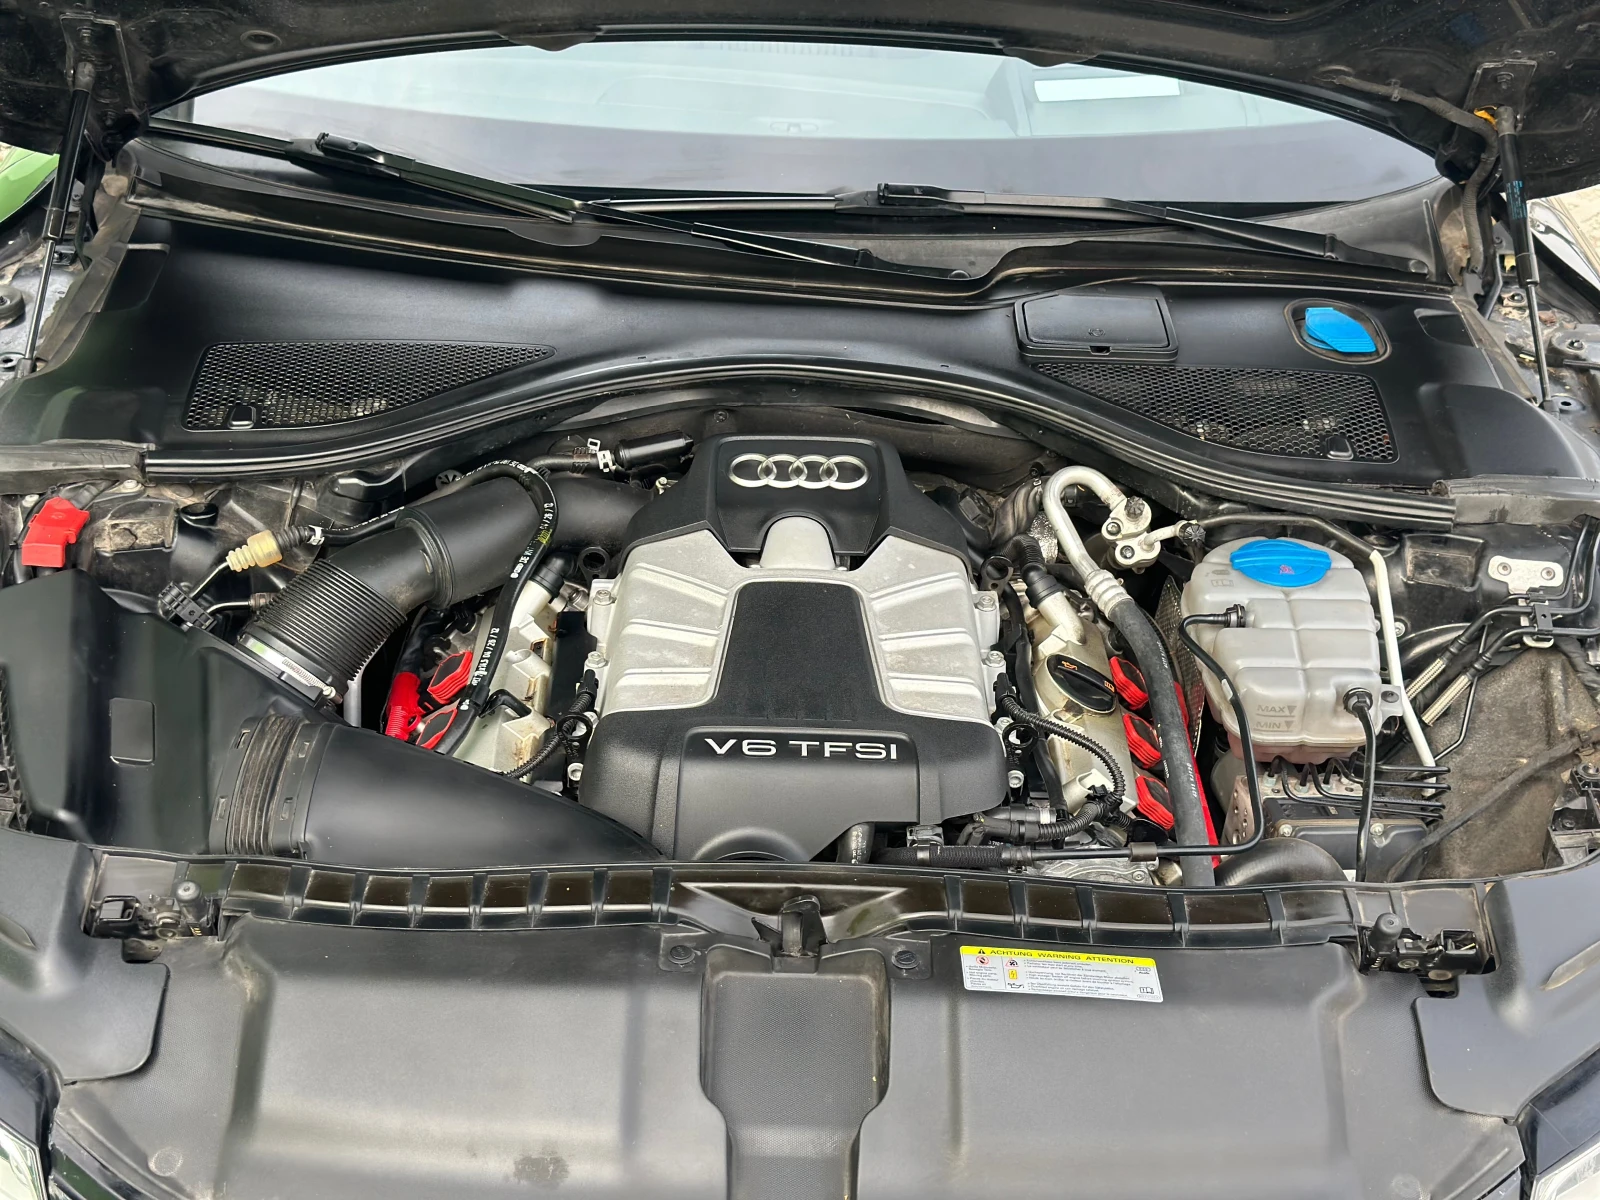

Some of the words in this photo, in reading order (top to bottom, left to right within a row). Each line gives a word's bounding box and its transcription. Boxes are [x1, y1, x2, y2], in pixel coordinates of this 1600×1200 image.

[1257, 704, 1286, 713] MAX
[1256, 721, 1281, 730] MIN
[704, 738, 777, 756] V6
[789, 740, 897, 760] TFSI
[990, 950, 1033, 958] ACHTUNG
[1038, 952, 1081, 961] WARNING
[1086, 955, 1135, 964] ATTENTION
